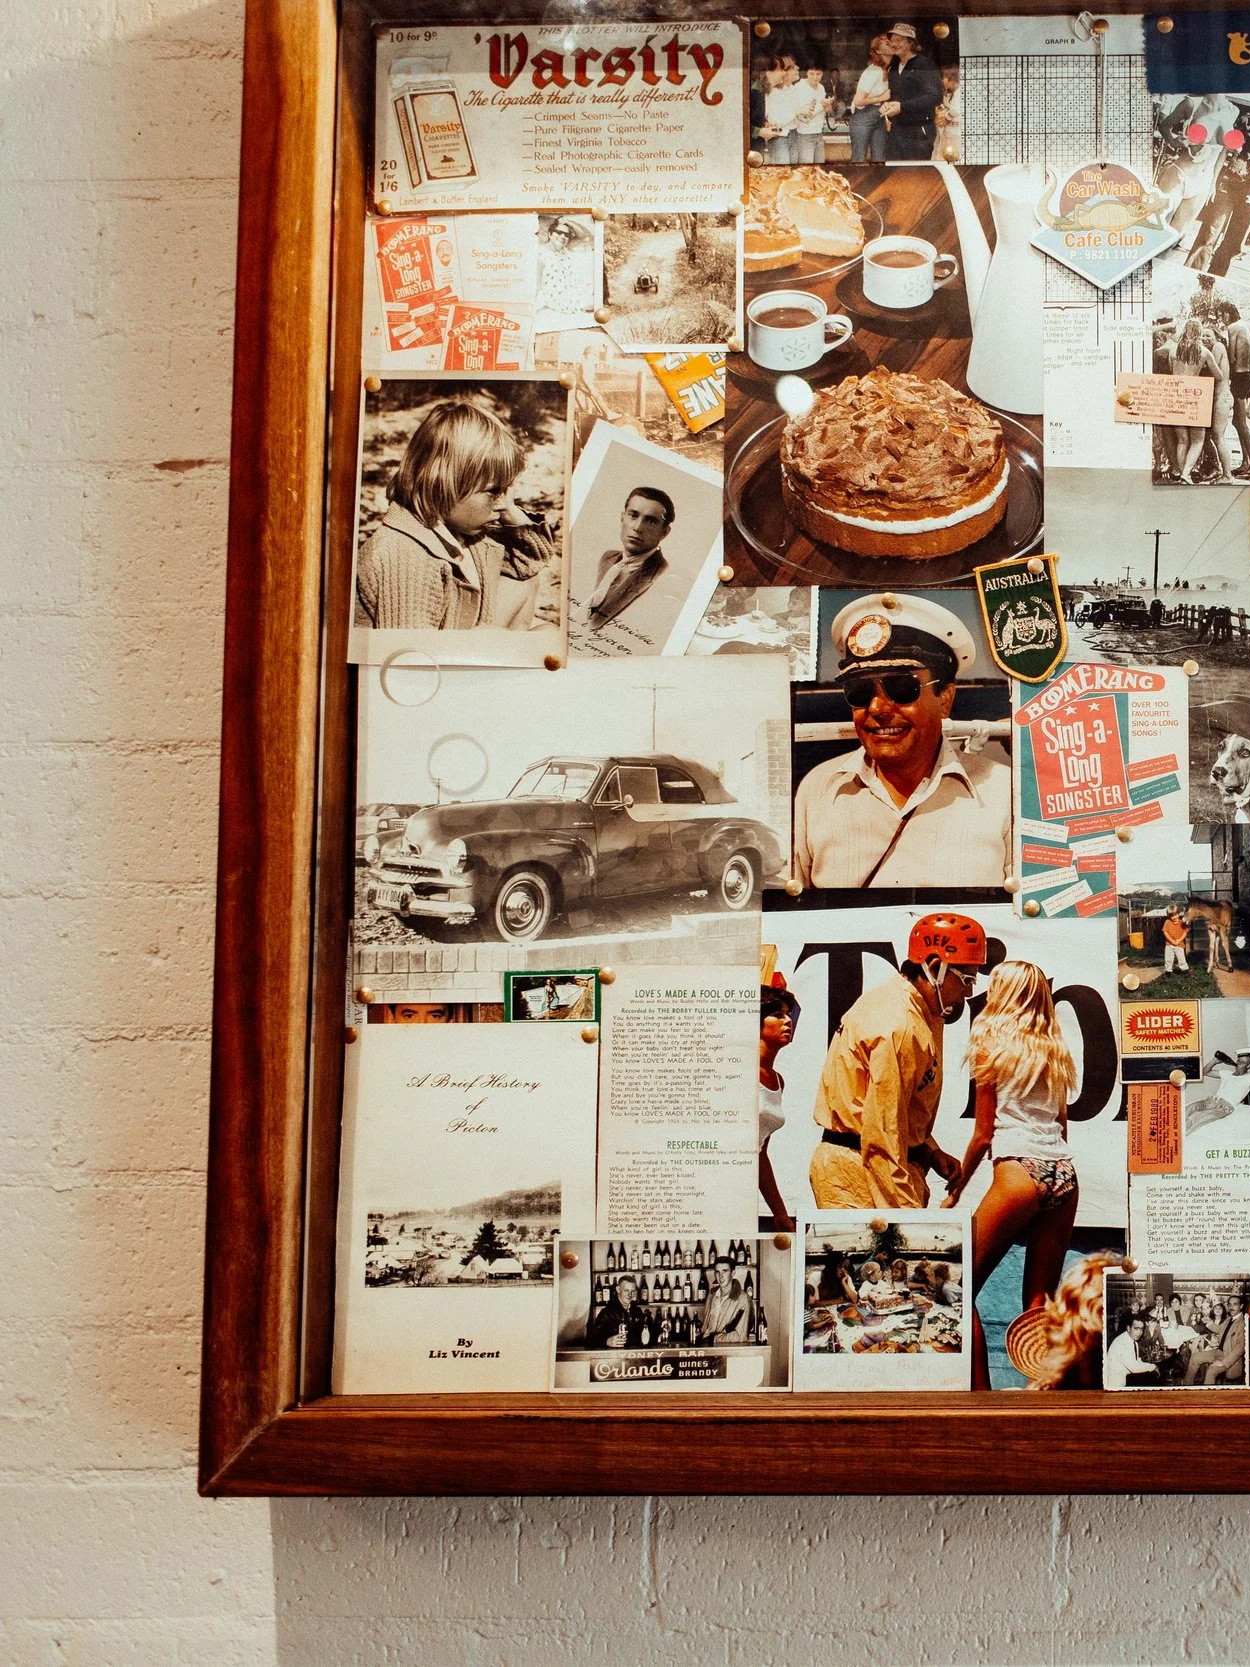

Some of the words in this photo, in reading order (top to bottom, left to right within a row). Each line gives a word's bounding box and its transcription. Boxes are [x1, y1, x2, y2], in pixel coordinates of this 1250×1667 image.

[463, 90, 488, 106] The
[491, 90, 544, 112] Cigarette
[544, 89, 573, 105] that
[574, 92, 586, 105] is
[590, 88, 630, 109] really
[632, 86, 699, 109] different!
[562, 125, 602, 135] Filigrane
[607, 124, 651, 134] Cigarette
[656, 123, 684, 134] Paper
[560, 150, 623, 161] Photographic
[627, 149, 673, 160] Cigarette
[675, 148, 704, 158] Cards
[380, 159, 397, 171] 20
[1082, 170, 1102, 182] The
[1067, 181, 1095, 198] Car
[1097, 180, 1141, 196] Wash
[1064, 230, 1102, 248] Café
[1107, 230, 1144, 247] Club
[471, 249, 522, 259] Sing-a-Long
[476, 262, 517, 271] Songsters
[984, 566, 1050, 592] AUSTRALIA
[1024, 663, 1155, 722] BOOMERANG
[1154, 700, 1169, 708] 100
[1131, 710, 1171, 718] FAVOURITE
[1059, 752, 1103, 788] Long
[1045, 788, 1123, 813] SONGSTER
[923, 933, 958, 954] DEVO
[634, 989, 662, 999] LOVE'S
[664, 989, 688, 998] MADE
[691, 989, 697, 998] A
[699, 989, 721, 998] FOOL
[724, 989, 736, 998] OF
[738, 989, 756, 998] YOU
[1136, 1015, 1183, 1030] LIDER
[406, 1073, 432, 1088] A
[430, 1072, 484, 1093] Brief
[480, 1073, 541, 1093] History
[465, 1096, 488, 1115] of
[445, 1117, 499, 1133] Picton
[666, 1140, 719, 1150] RESPECTABLE
[1205, 1150, 1220, 1159] GET
[1223, 1150, 1230, 1159] A
[456, 1338, 473, 1348] By
[429, 1350, 448, 1359] Liz
[452, 1350, 501, 1359] Vincent
[593, 1358, 674, 1380] Orlando
[679, 1360, 709, 1368] WINES
[678, 1369, 718, 1377] BRANDY
